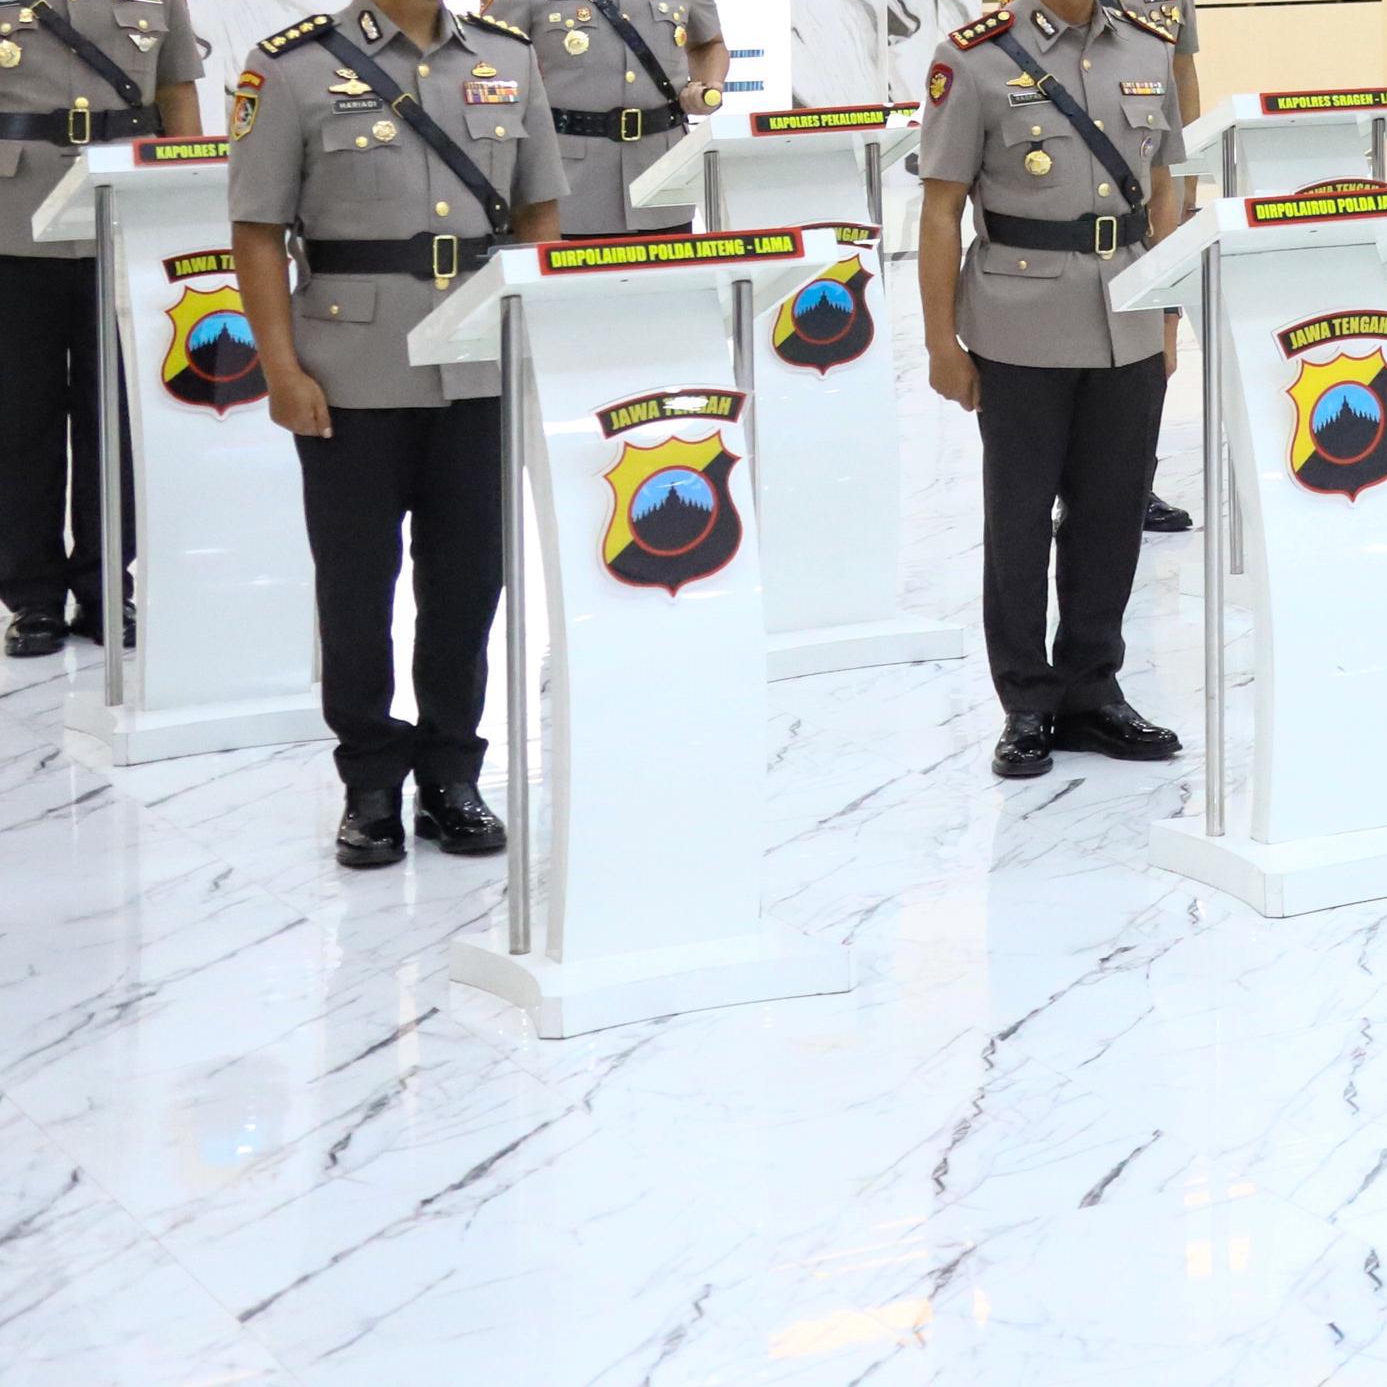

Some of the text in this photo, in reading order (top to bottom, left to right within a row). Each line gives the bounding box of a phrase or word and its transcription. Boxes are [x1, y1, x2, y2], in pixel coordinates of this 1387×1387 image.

[1278, 96, 1331, 109] KAPOLRES
[1332, 94, 1373, 106] SRAGEN
[769, 116, 820, 130] KAPOLRES
[821, 111, 884, 126] PEKALONGAN
[156, 144, 216, 160] KAPOLRES
[1256, 200, 1336, 220] DIRPOLAIRUD
[1337, 198, 1376, 213] POLDA
[551, 246, 647, 268] DIRPOLAIRUD
[649, 243, 694, 260] POLDA
[697, 239, 744, 257] JATENG
[754, 236, 793, 254] LAMA
[175, 256, 217, 276] JAWA
[1290, 322, 1331, 349] JAWA
[610, 400, 660, 430] JAWA
